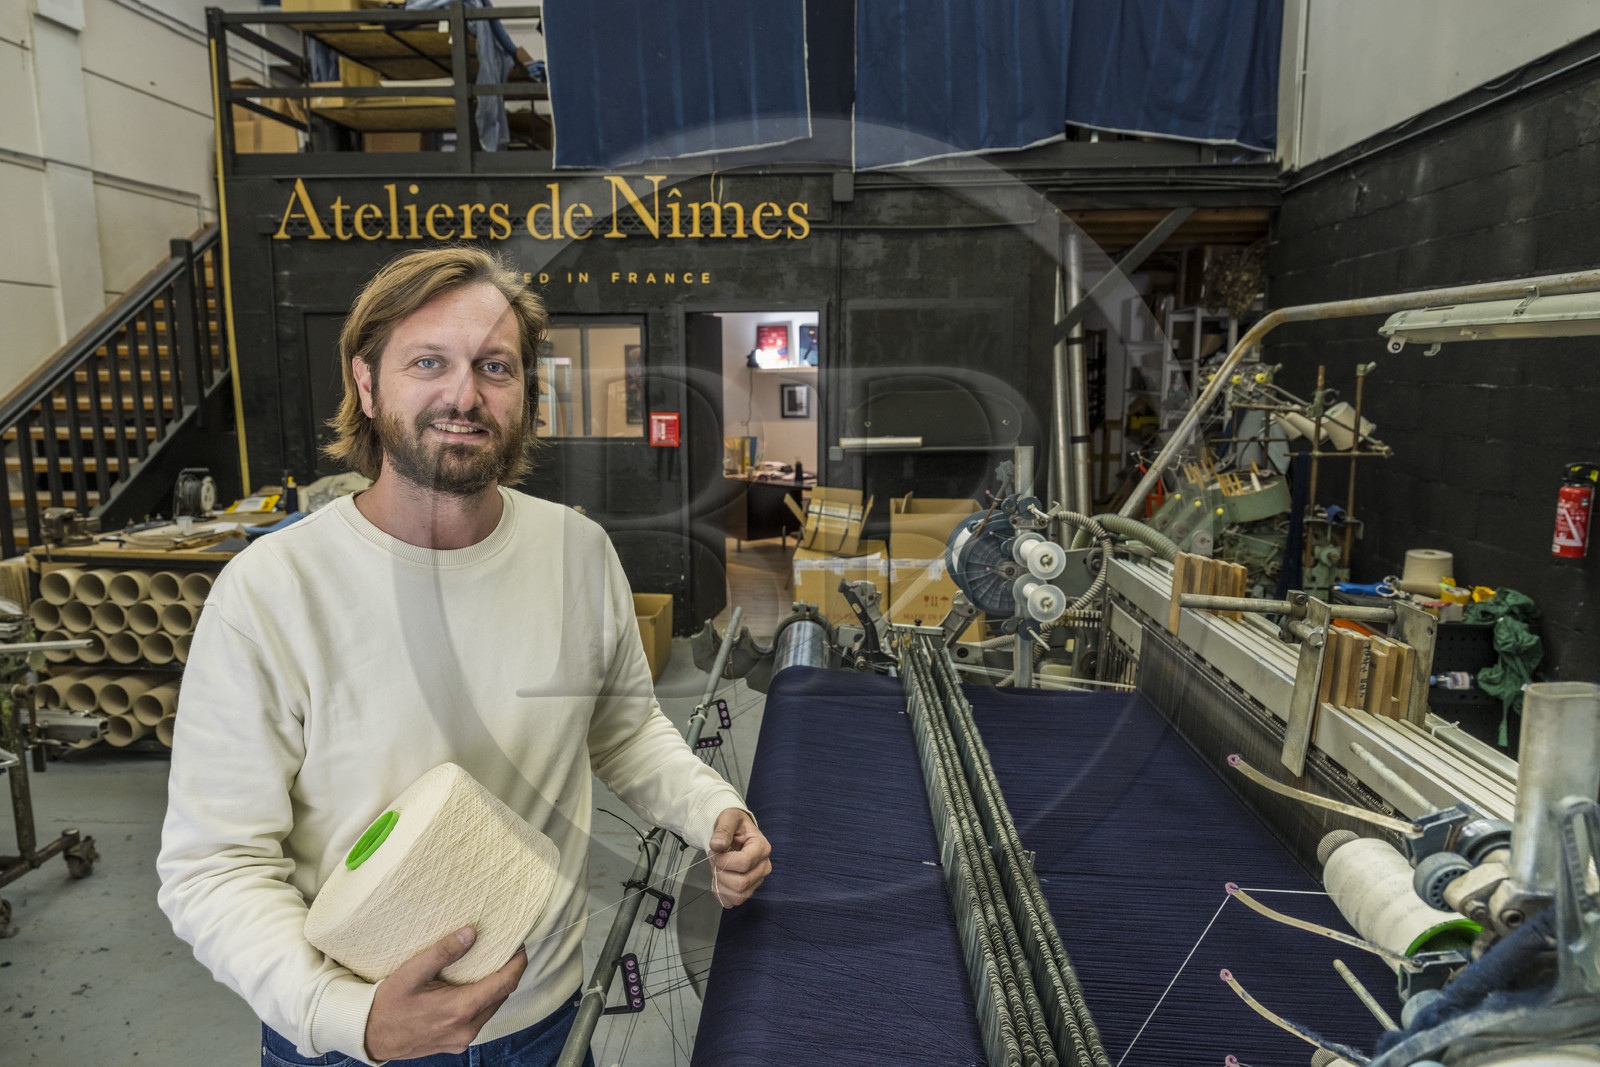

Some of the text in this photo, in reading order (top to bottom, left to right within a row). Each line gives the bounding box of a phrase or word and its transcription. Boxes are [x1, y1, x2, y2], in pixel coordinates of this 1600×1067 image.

[273, 175, 811, 241] Ateliers de Nîmes
[567, 272, 589, 284] IN
[611, 272, 711, 284] FRANCE
